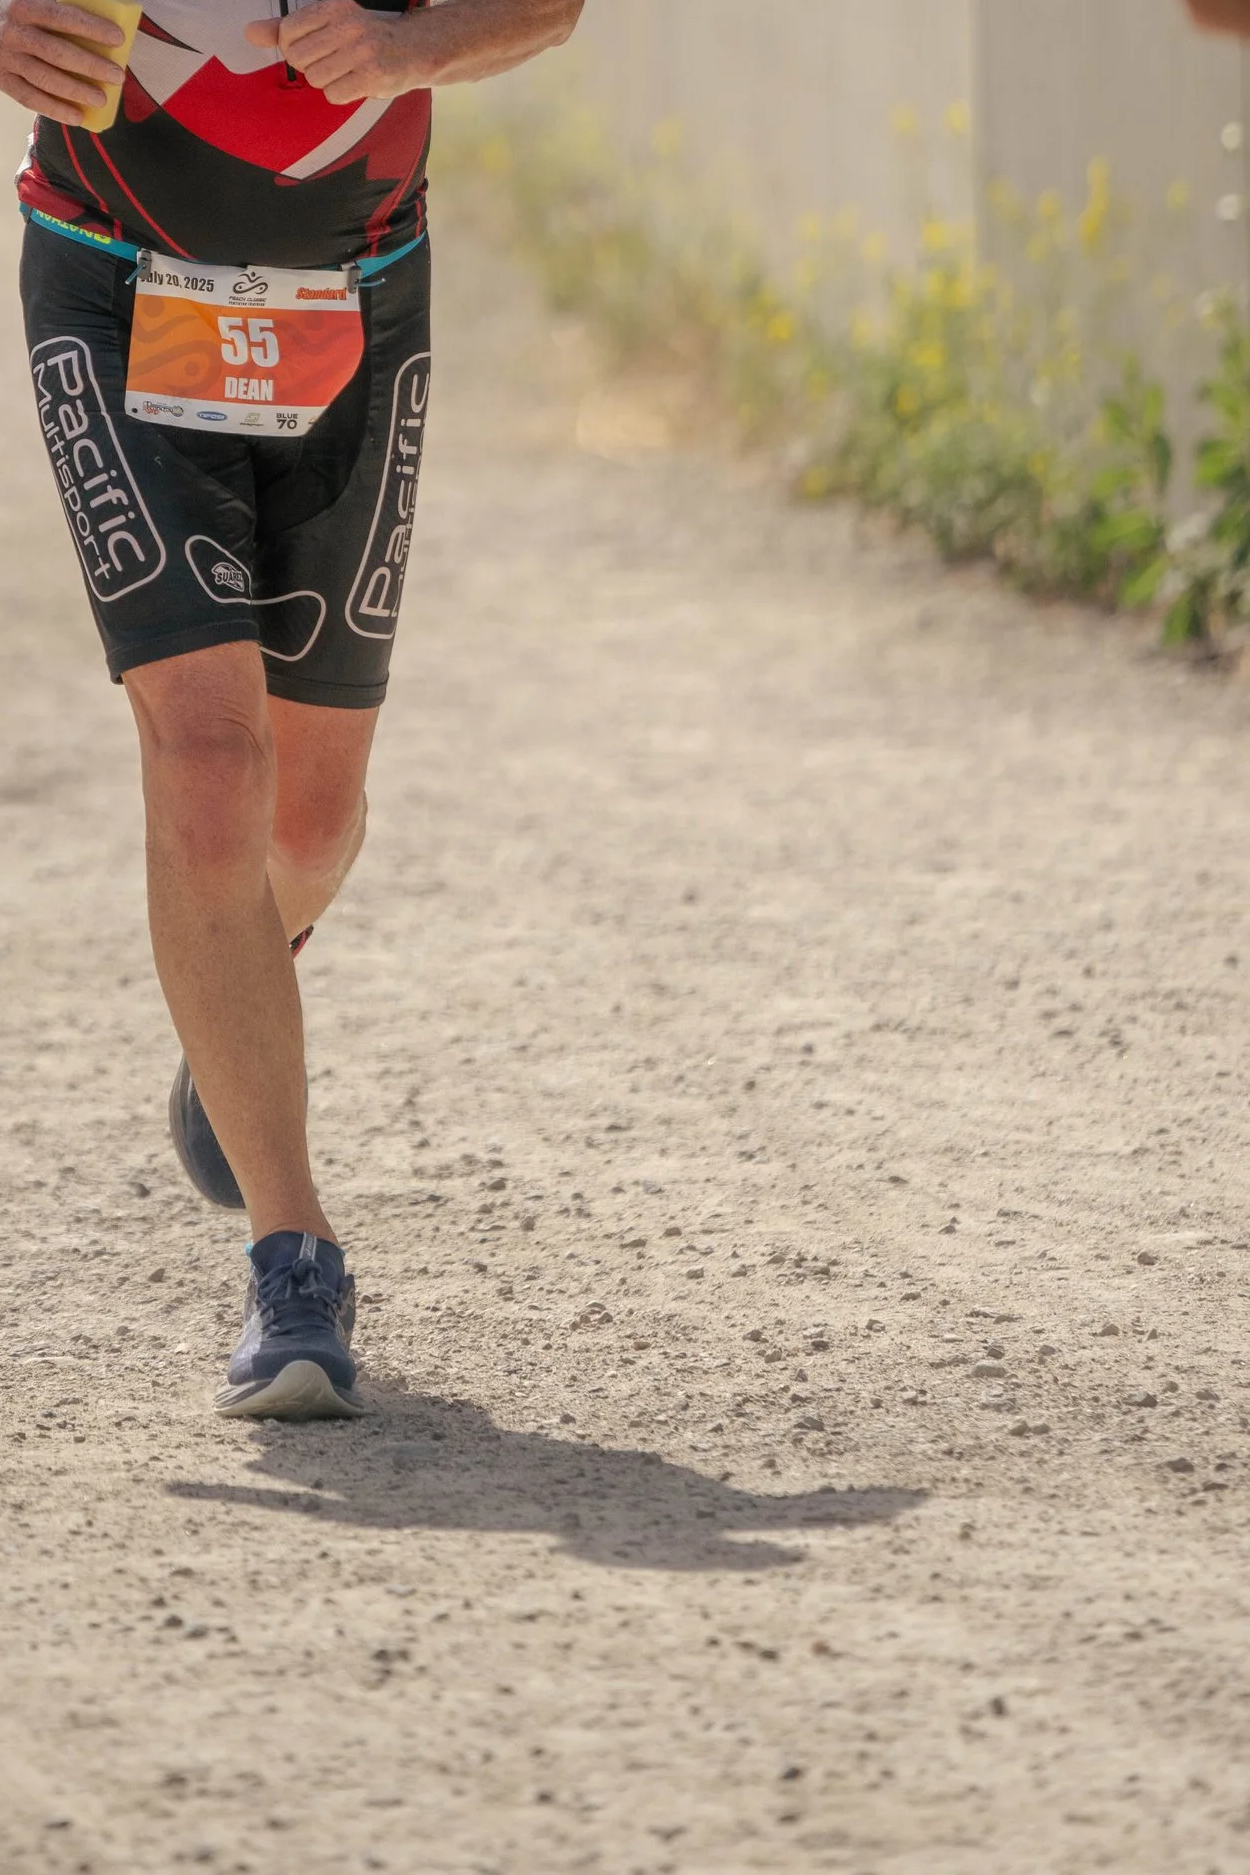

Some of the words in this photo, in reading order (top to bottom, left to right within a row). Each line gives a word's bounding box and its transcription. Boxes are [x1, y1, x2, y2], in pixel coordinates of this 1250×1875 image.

[140, 271, 164, 286] uly
[166, 273, 183, 289] 20,
[184, 276, 215, 293] 2025
[295, 286, 348, 301] Standard
[217, 316, 280, 368] 55
[224, 376, 274, 402] DEAN
[276, 412, 299, 420] BLUE
[276, 418, 298, 430] 70
[33, 361, 111, 579] Multisport
[47, 350, 146, 572] Pacific
[358, 372, 430, 617] Pacific
